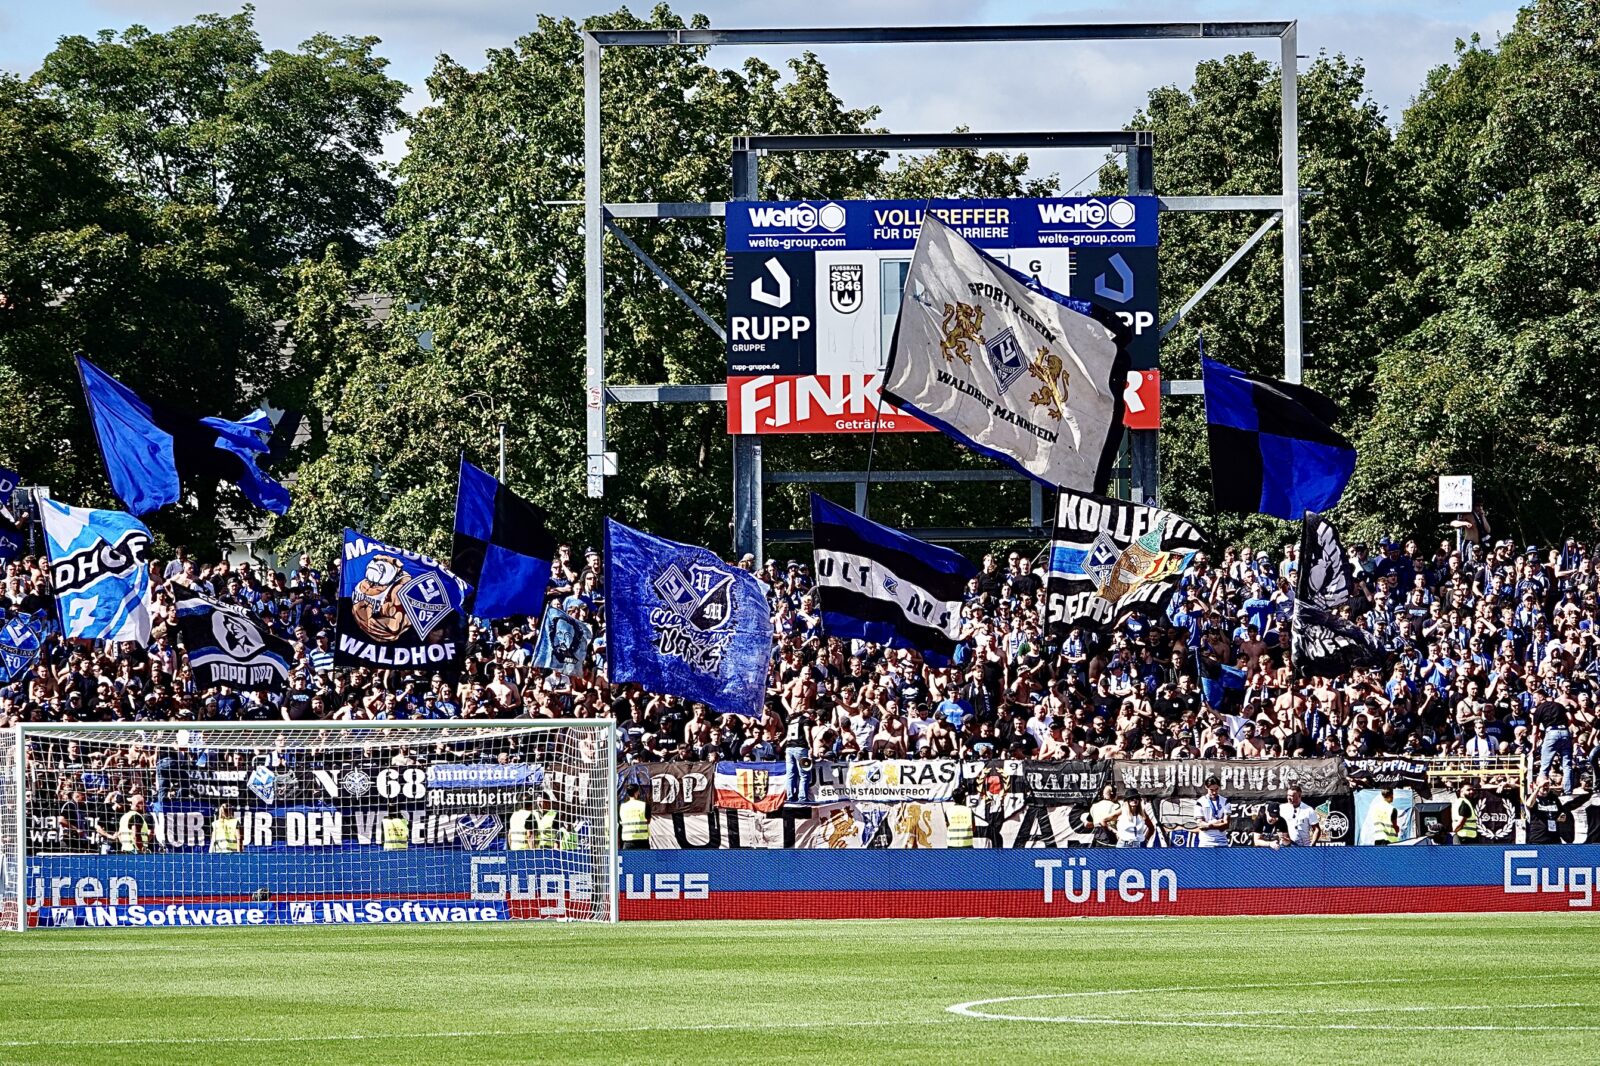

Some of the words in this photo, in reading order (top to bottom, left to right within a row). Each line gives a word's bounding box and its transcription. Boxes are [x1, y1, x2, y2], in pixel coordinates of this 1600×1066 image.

[749, 238, 846, 248] welte-group.com
[874, 227, 899, 239] FÜR
[1038, 234, 1135, 245] welte-group.com
[831, 272, 861, 281] SSV
[831, 281, 861, 291] 1846
[967, 282, 1056, 344] SPORTVEREIN
[732, 316, 811, 340] RUPP
[732, 344, 766, 352] GRUPPE
[732, 363, 780, 371] rupp-gruppe.de
[937, 369, 994, 409] WALDHOF
[836, 420, 895, 430] Getränke
[818, 557, 870, 587] ULT
[419, 610, 434, 621] 07
[339, 633, 456, 665] WALDHOF
[210, 663, 247, 684] DOPA
[376, 768, 427, 799] 68
[427, 765, 518, 782] Immortale
[899, 762, 955, 785] RAS
[1120, 764, 1214, 789] WALDHOF
[193, 783, 240, 798] OLVES
[426, 789, 518, 807] Mannheim
[650, 773, 708, 804] DP
[821, 787, 857, 797] SEKTION
[858, 787, 932, 797] STADIONVERBOT
[286, 811, 342, 846] DEN
[26, 865, 138, 913] üren
[1034, 857, 1178, 903] Türen
[1503, 850, 1600, 907] Gug
[84, 905, 265, 927] IN-Software
[322, 901, 498, 922] IN-Software
